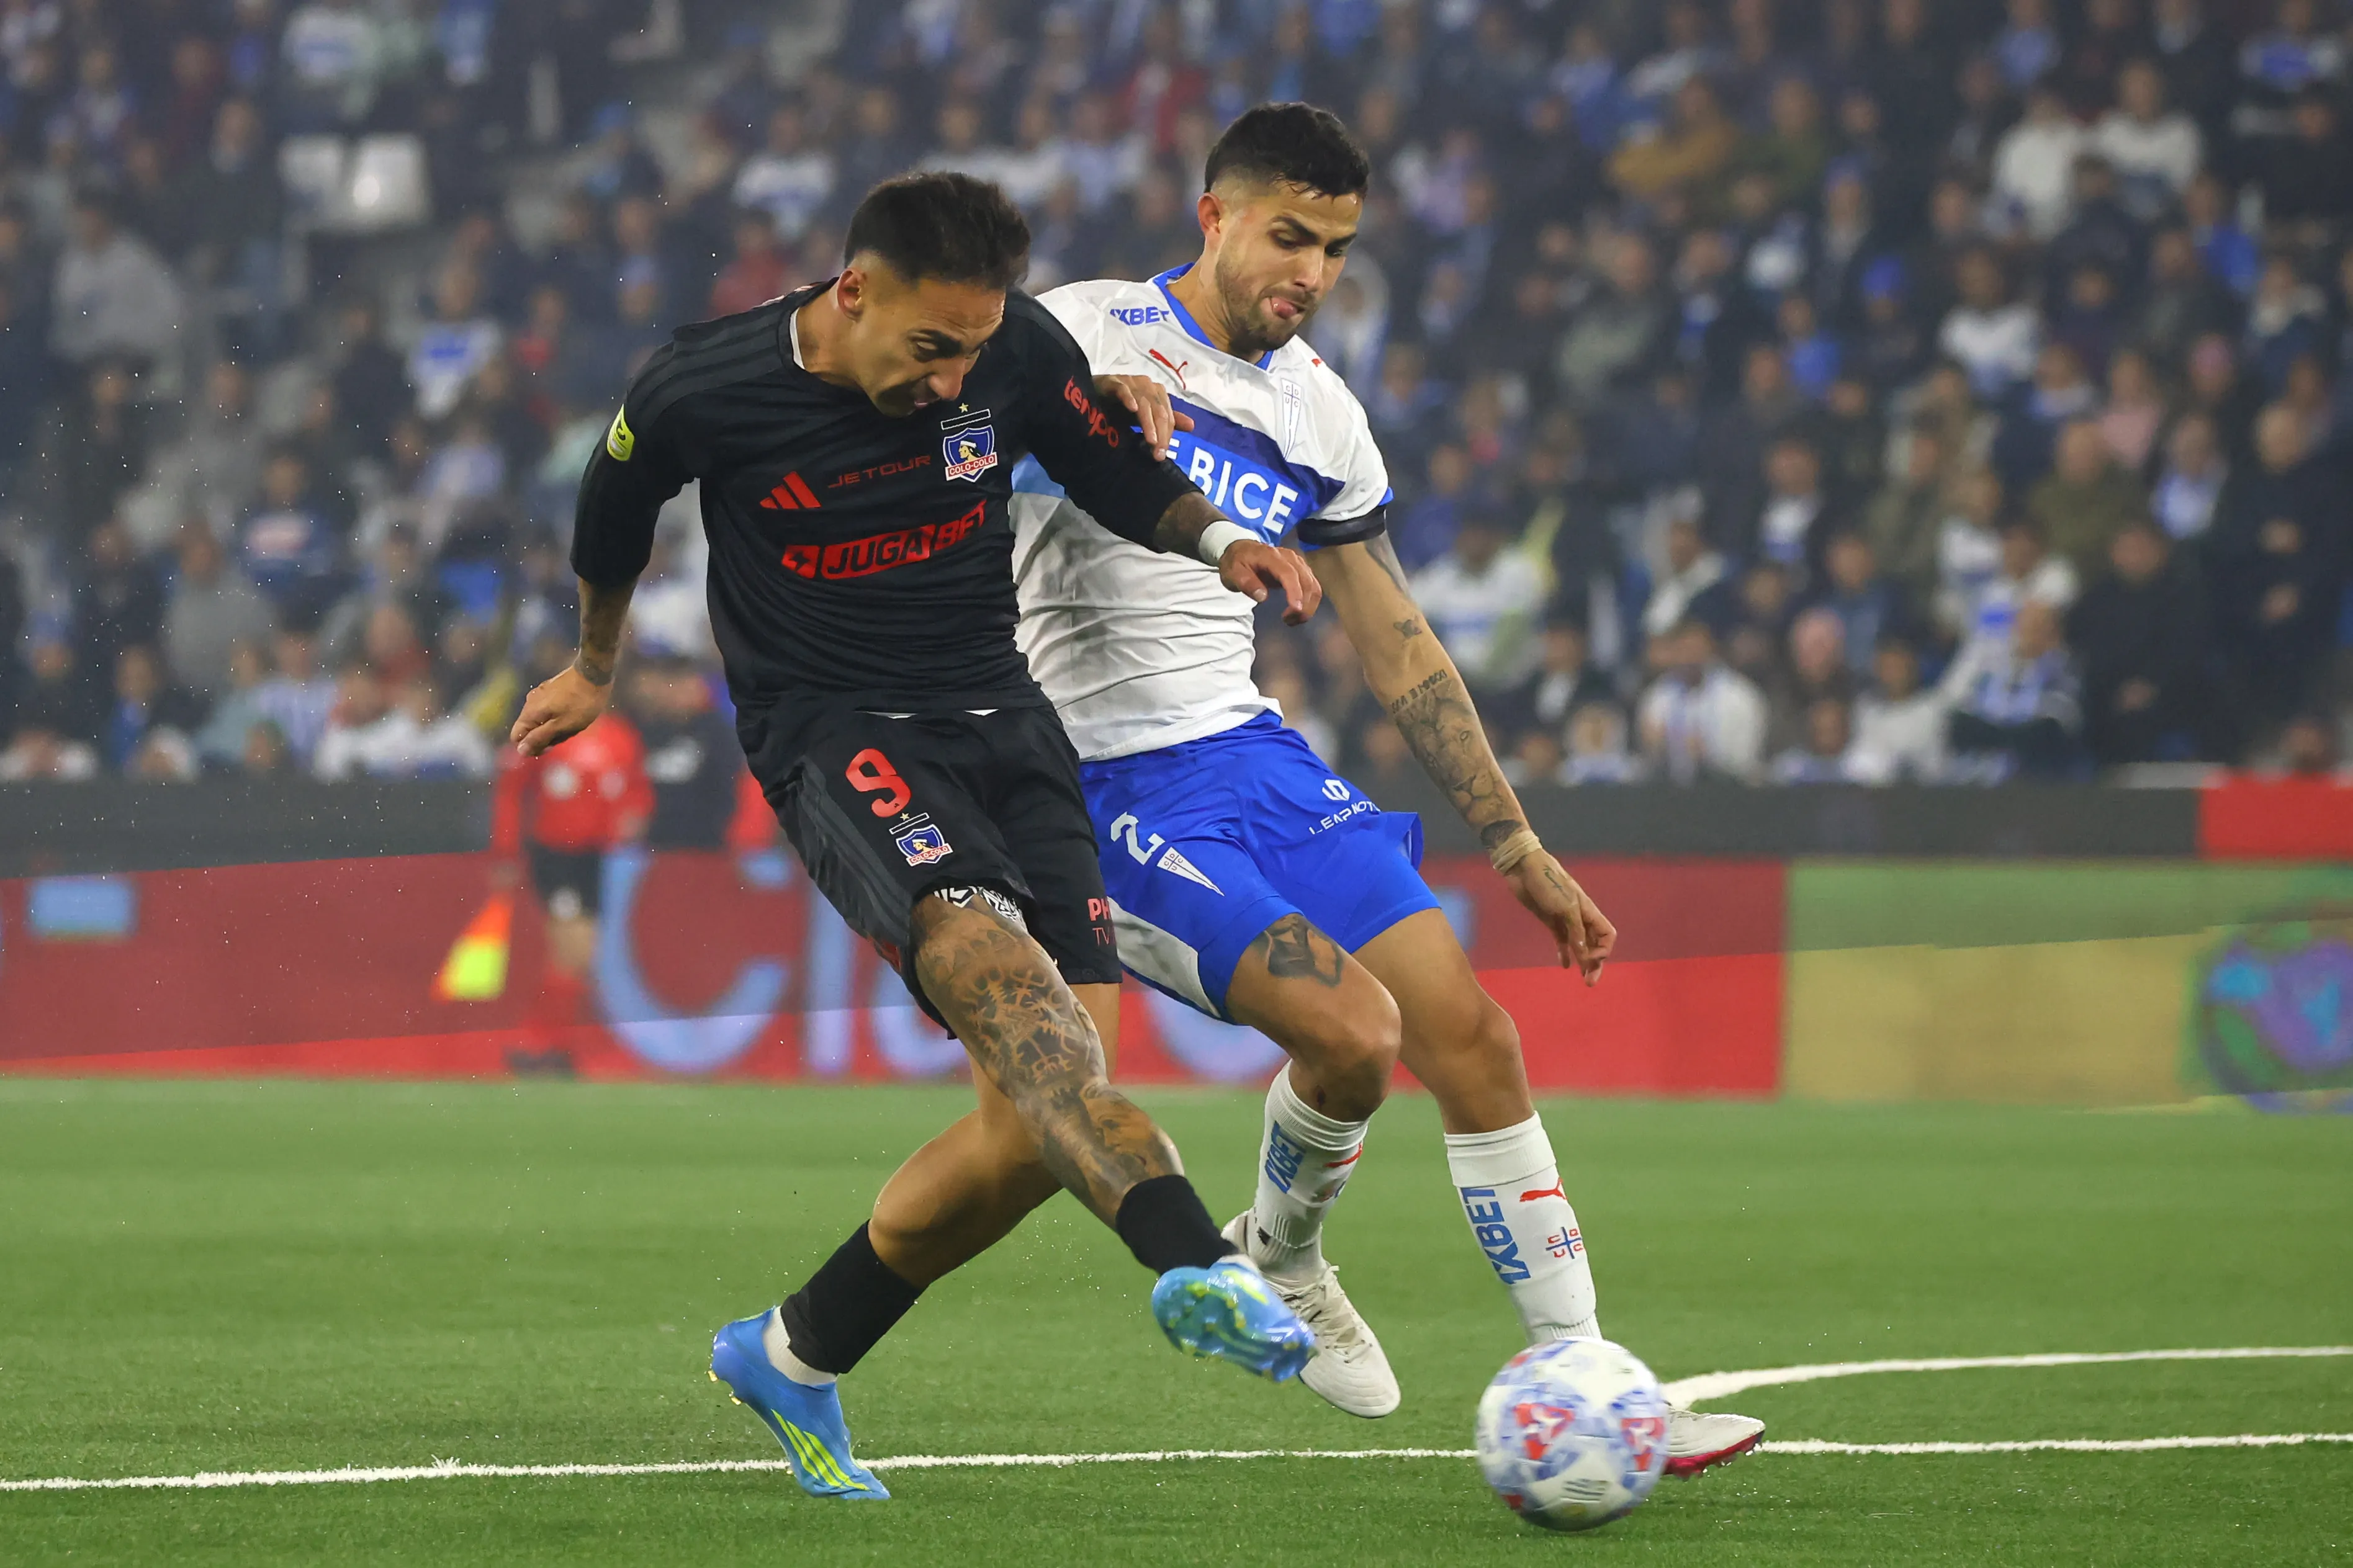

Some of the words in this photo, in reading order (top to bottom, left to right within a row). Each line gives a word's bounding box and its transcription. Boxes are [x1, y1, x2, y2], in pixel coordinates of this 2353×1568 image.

[1064, 375, 1119, 447] tenpo
[827, 454, 931, 488] JETOUR
[948, 457, 995, 475] COLO-COLO
[1189, 446, 1299, 535] BICE
[845, 748, 912, 818] 9
[911, 846, 949, 863] COLO-COLO
[1110, 811, 1166, 866] 2
[1087, 898, 1111, 921] PH
[1461, 1186, 1531, 1285] 1XBET
